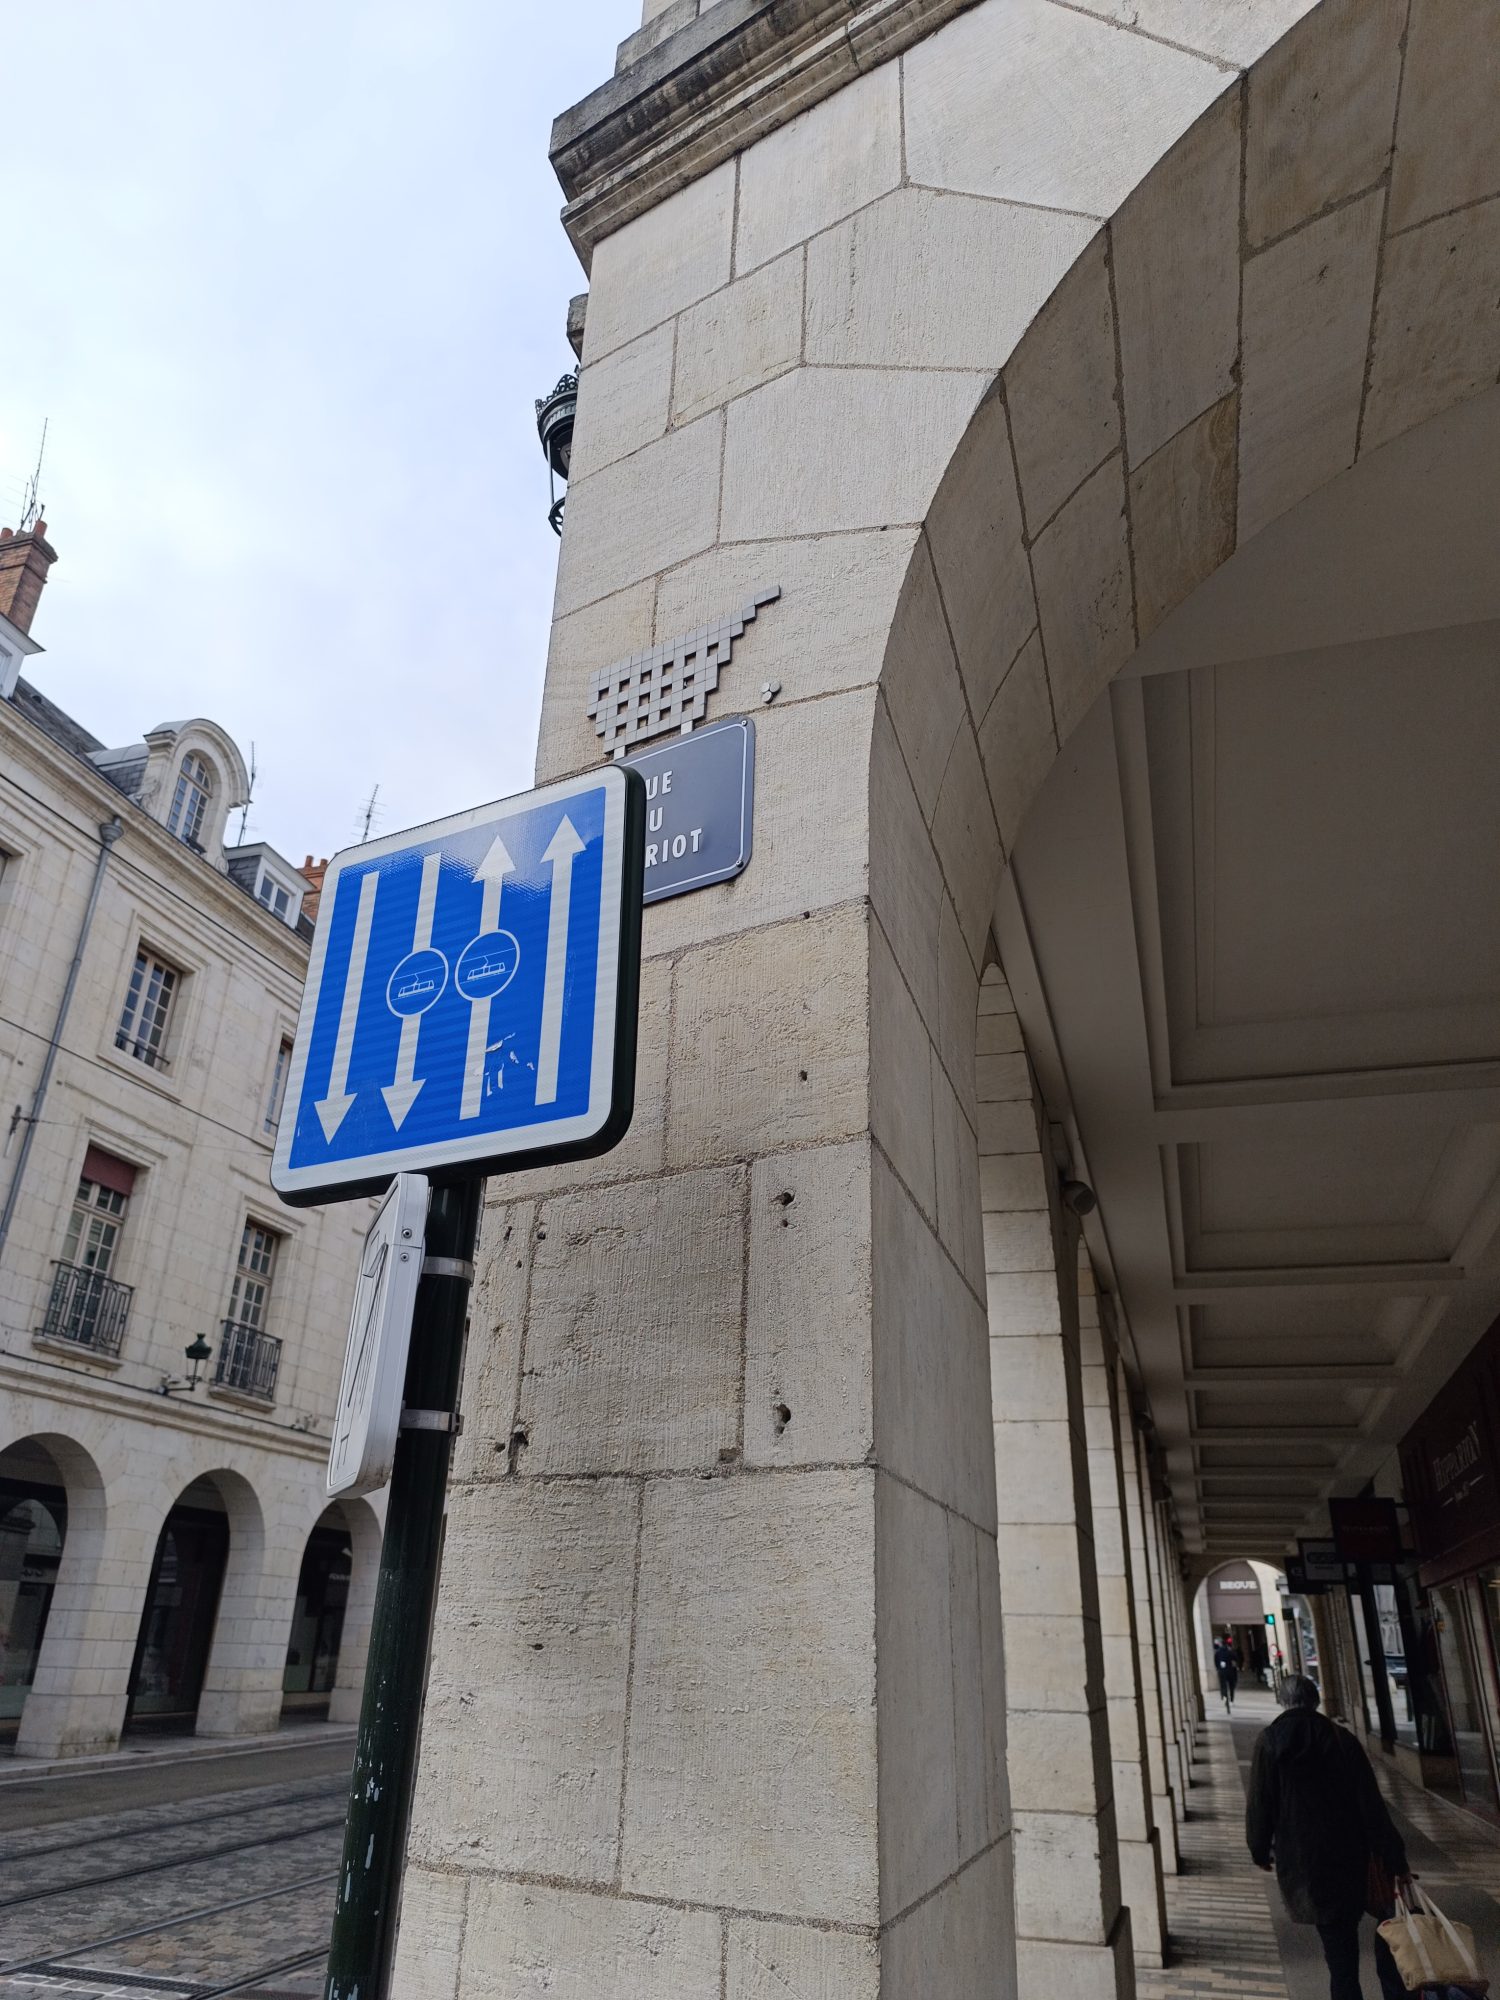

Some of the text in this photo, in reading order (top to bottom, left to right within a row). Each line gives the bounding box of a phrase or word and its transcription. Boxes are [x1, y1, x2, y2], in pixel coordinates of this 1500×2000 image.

[645, 770, 673, 800] UE
[649, 806, 664, 832] U
[645, 828, 702, 868] RIOT
